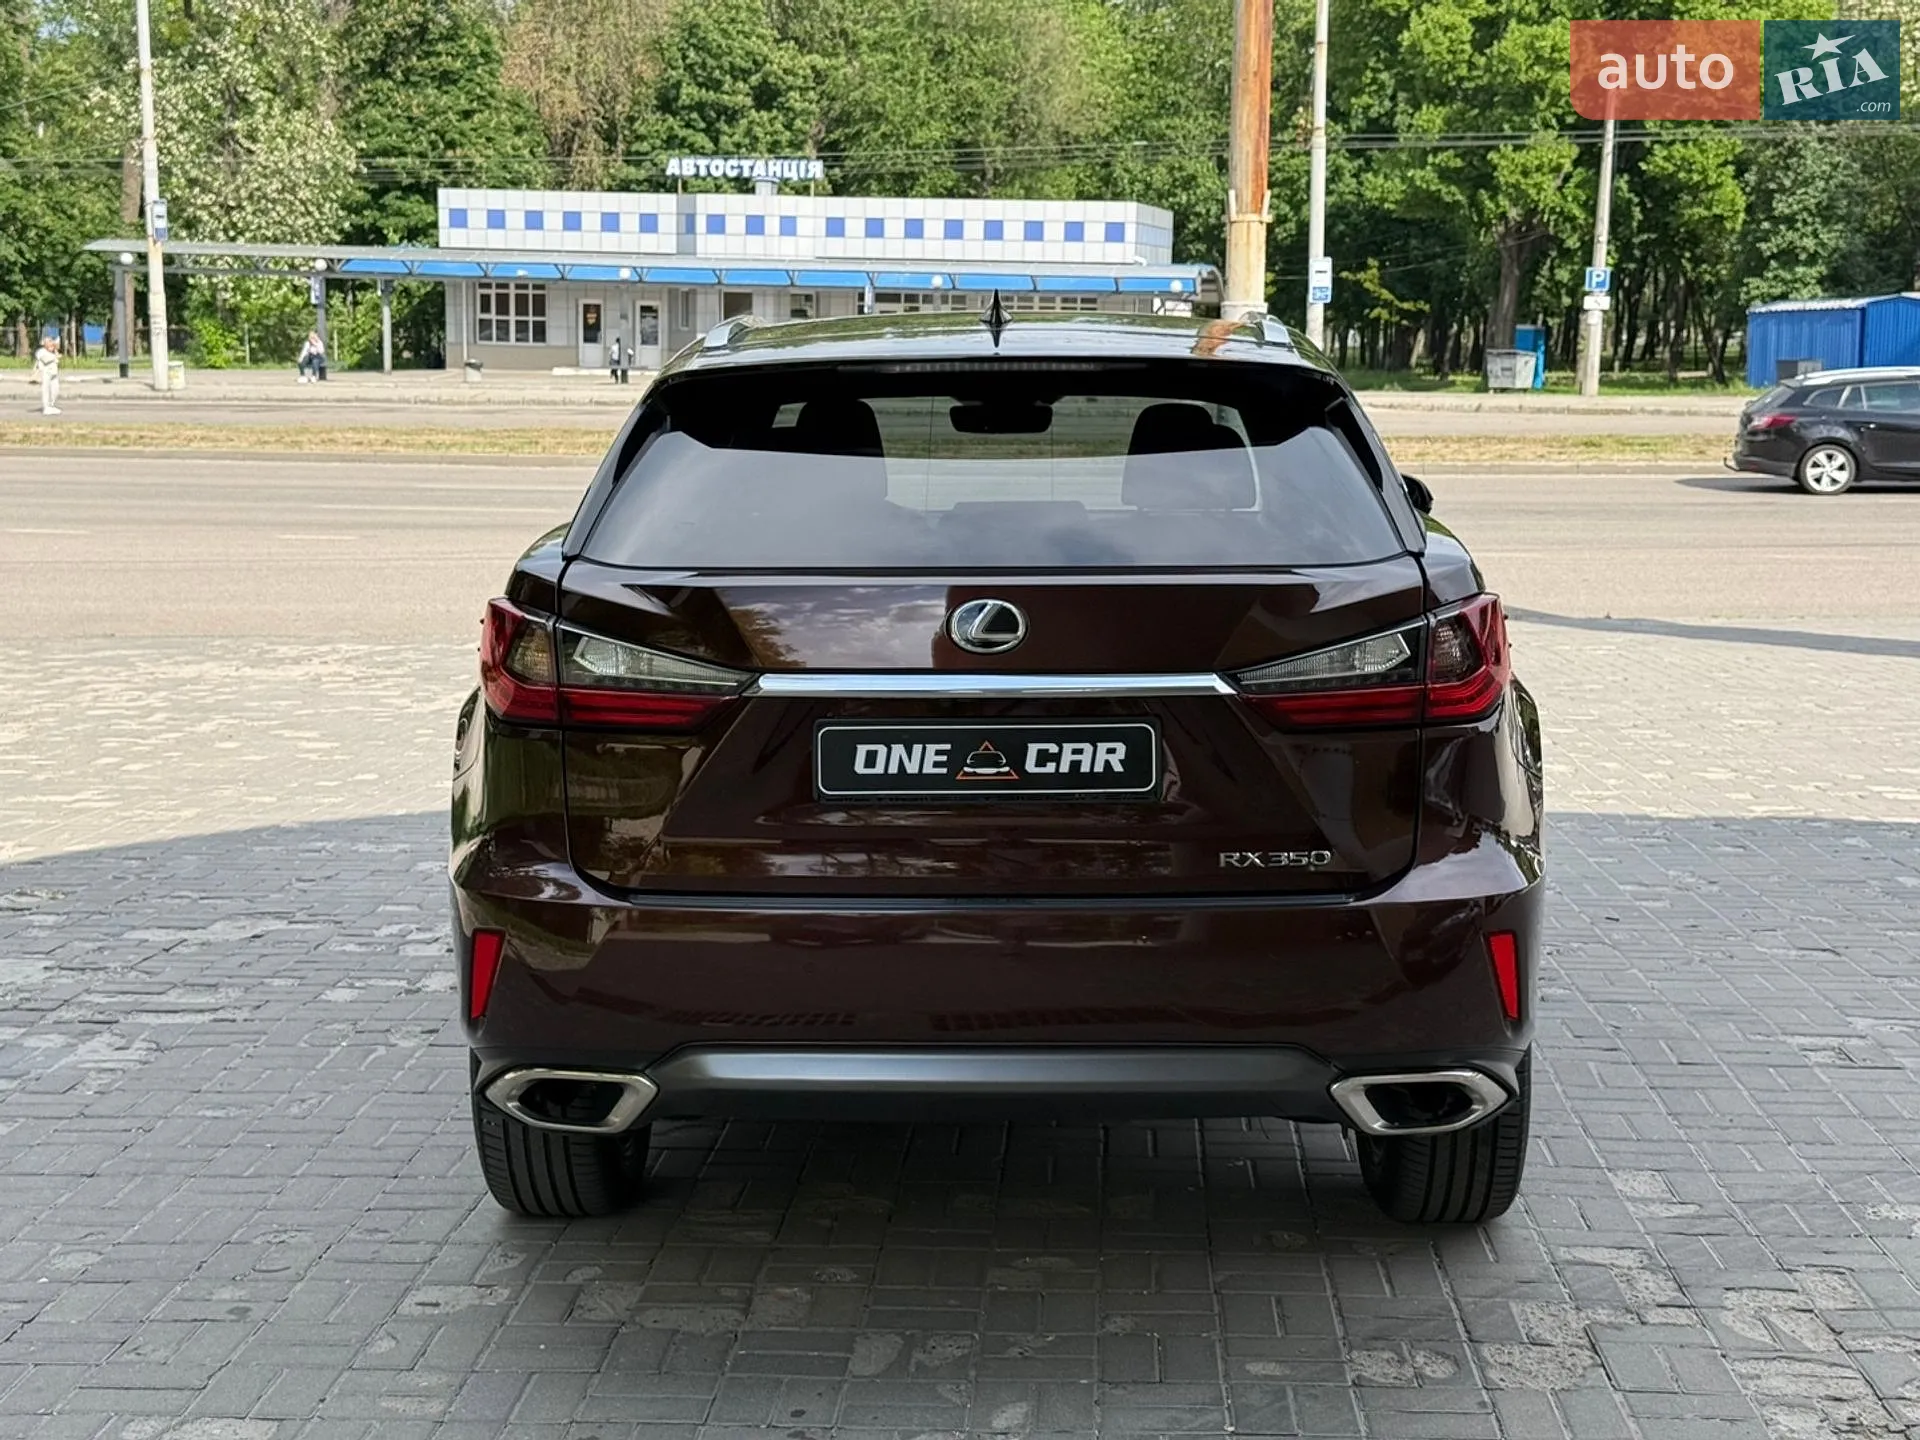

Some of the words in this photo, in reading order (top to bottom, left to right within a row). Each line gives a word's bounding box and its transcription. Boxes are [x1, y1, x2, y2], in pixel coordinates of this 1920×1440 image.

[666, 157, 823, 180] АВТОСТАНЦІЯ
[1591, 270, 1606, 289] P
[853, 743, 952, 775] ONE
[1025, 742, 1127, 774] CAR
